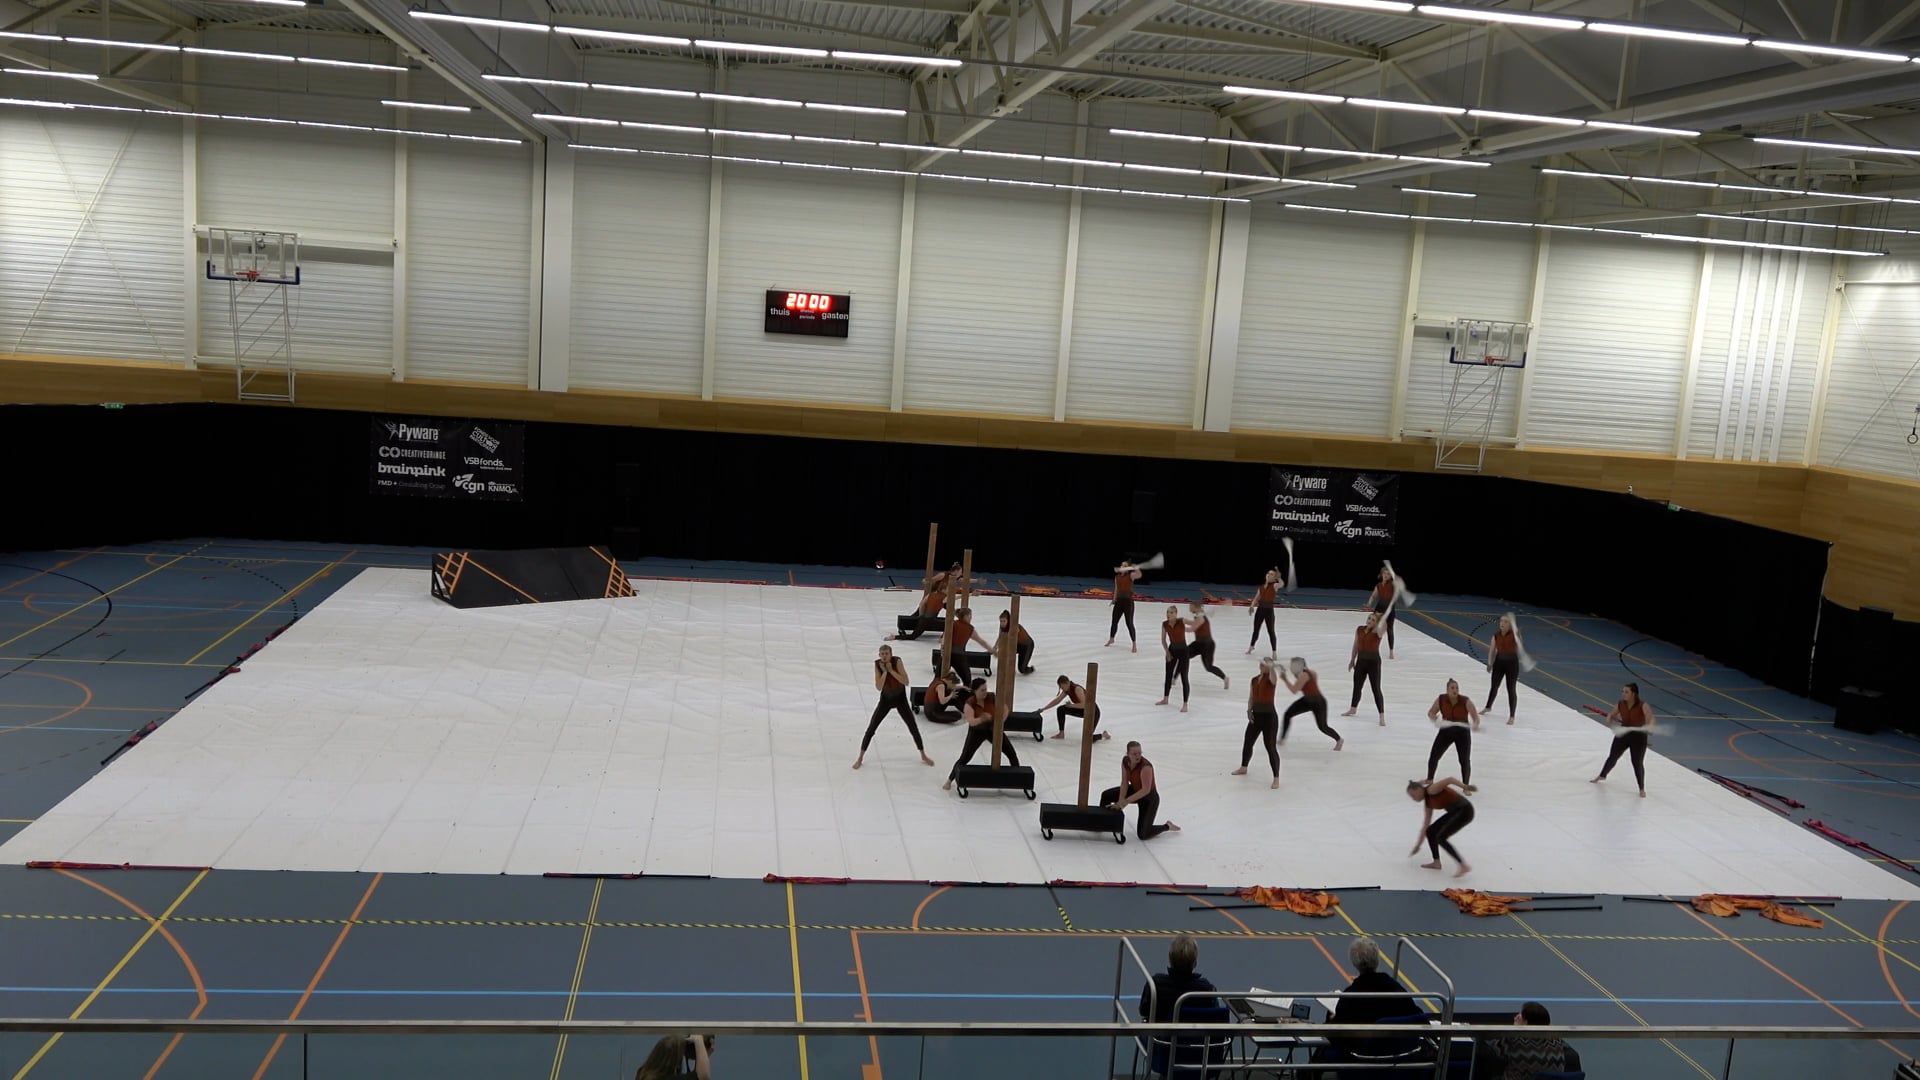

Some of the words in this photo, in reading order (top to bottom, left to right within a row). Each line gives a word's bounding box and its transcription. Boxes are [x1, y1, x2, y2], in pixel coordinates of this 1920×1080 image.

[770, 307, 790, 316] thuis
[821, 312, 849, 320] gasten
[398, 423, 440, 442] Pyware
[378, 461, 446, 477] brainpink
[462, 480, 485, 494] cgn
[1292, 474, 1327, 491] Pyware
[1272, 508, 1330, 523] brainpink
[1342, 527, 1362, 538] cgn
